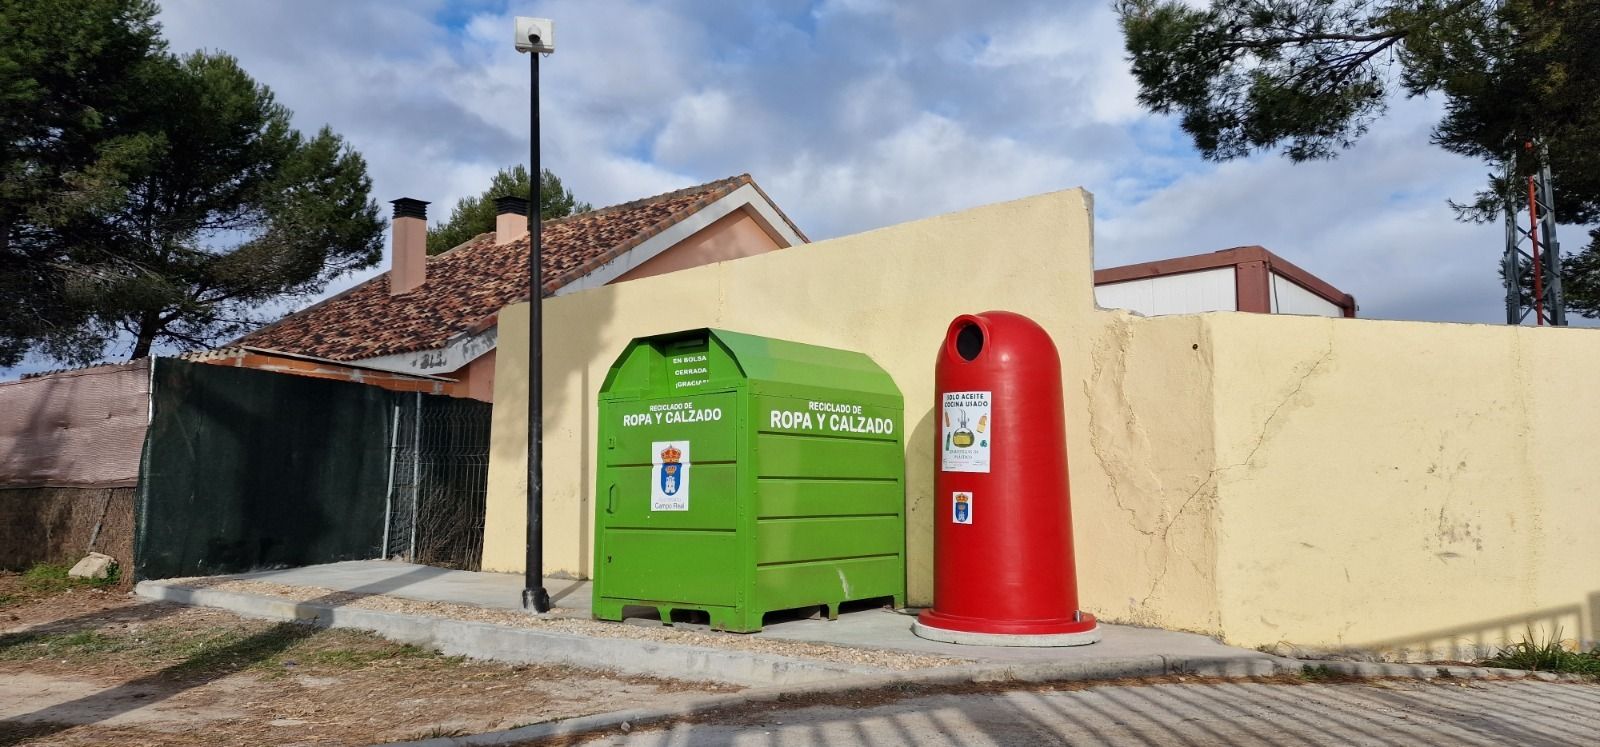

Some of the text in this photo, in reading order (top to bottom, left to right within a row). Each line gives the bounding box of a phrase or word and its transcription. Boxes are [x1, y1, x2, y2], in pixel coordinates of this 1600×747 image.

[674, 368, 707, 376] CERRADA
[650, 404, 682, 412] RECICLADO
[809, 401, 862, 414] RECICLADO DE
[624, 408, 722, 426] ROPA Y CALZADO
[770, 410, 893, 434] ROPA Y CALZADO
